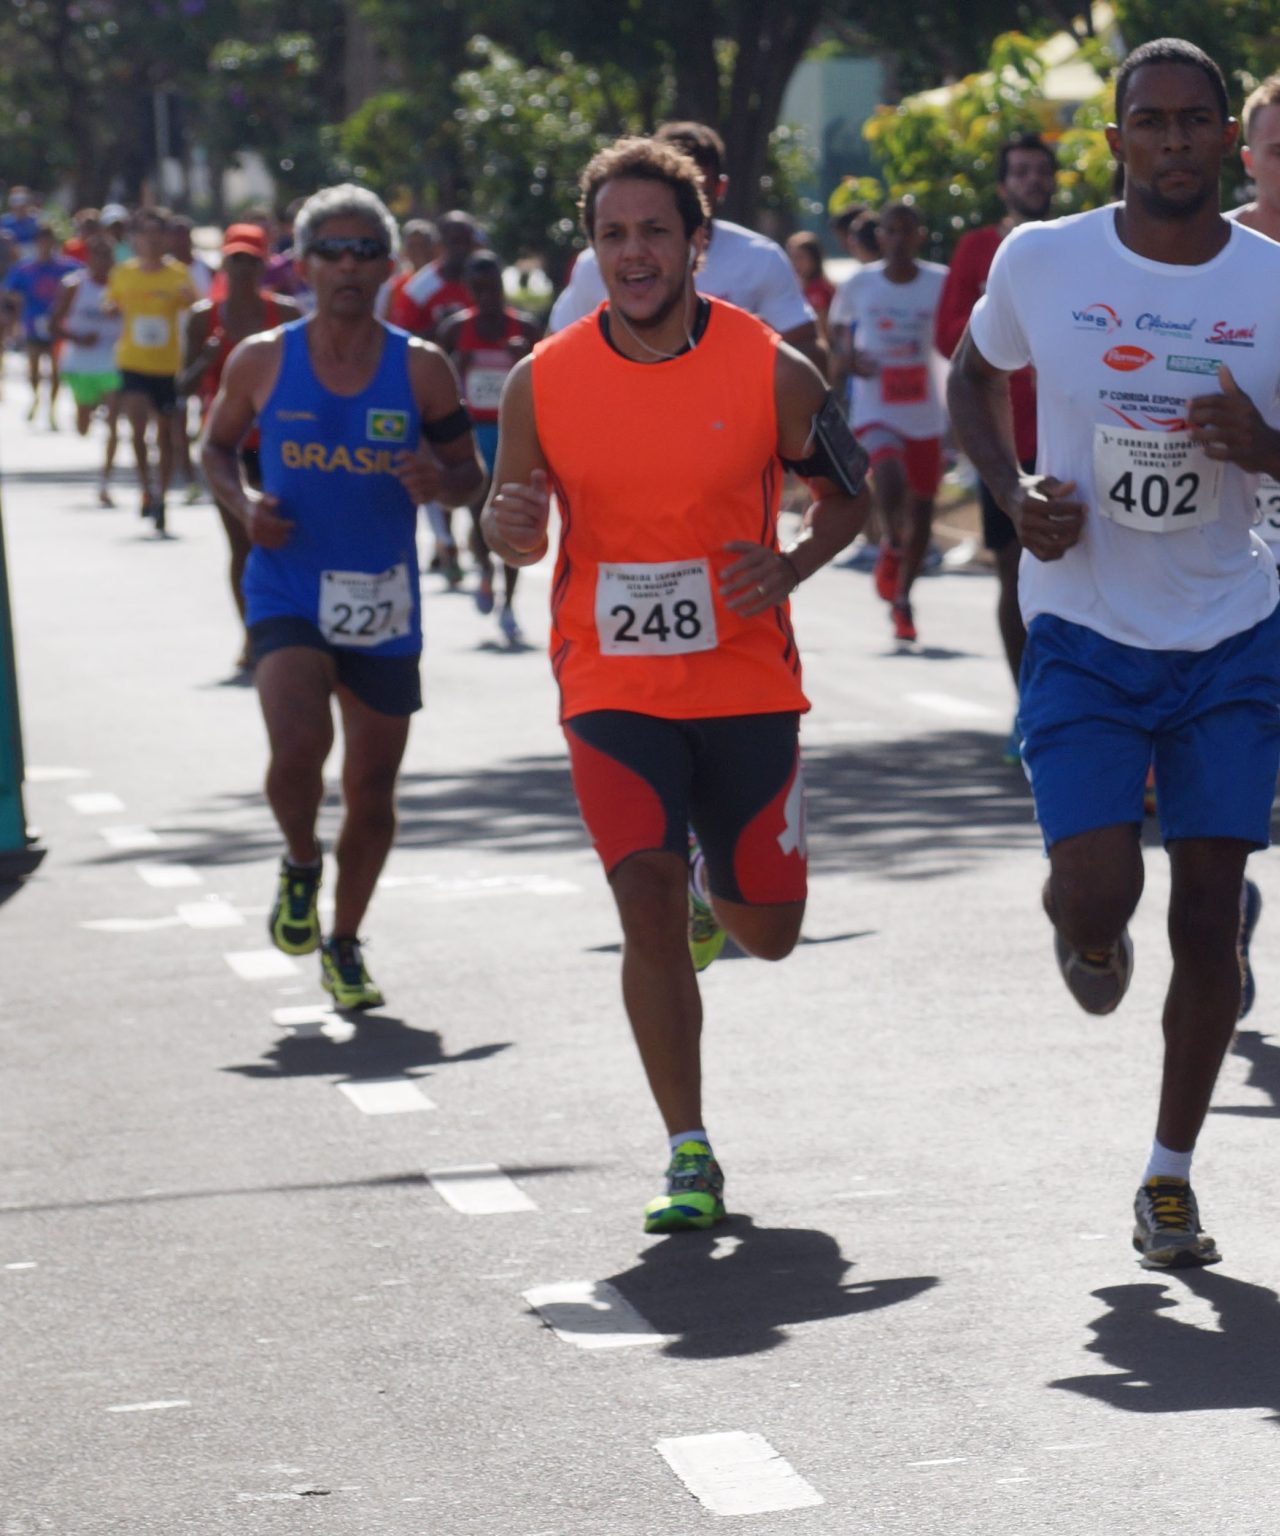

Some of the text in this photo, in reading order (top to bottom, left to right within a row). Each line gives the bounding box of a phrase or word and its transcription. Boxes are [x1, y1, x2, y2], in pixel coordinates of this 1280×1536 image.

[1209, 321, 1257, 342] Sami
[1110, 391, 1149, 402] CORRIDA
[281, 440, 400, 475] BRASIL
[1117, 438, 1160, 449] CORRIDA
[1109, 471, 1201, 518] 402
[332, 600, 393, 636] 227
[610, 599, 702, 642] 248
